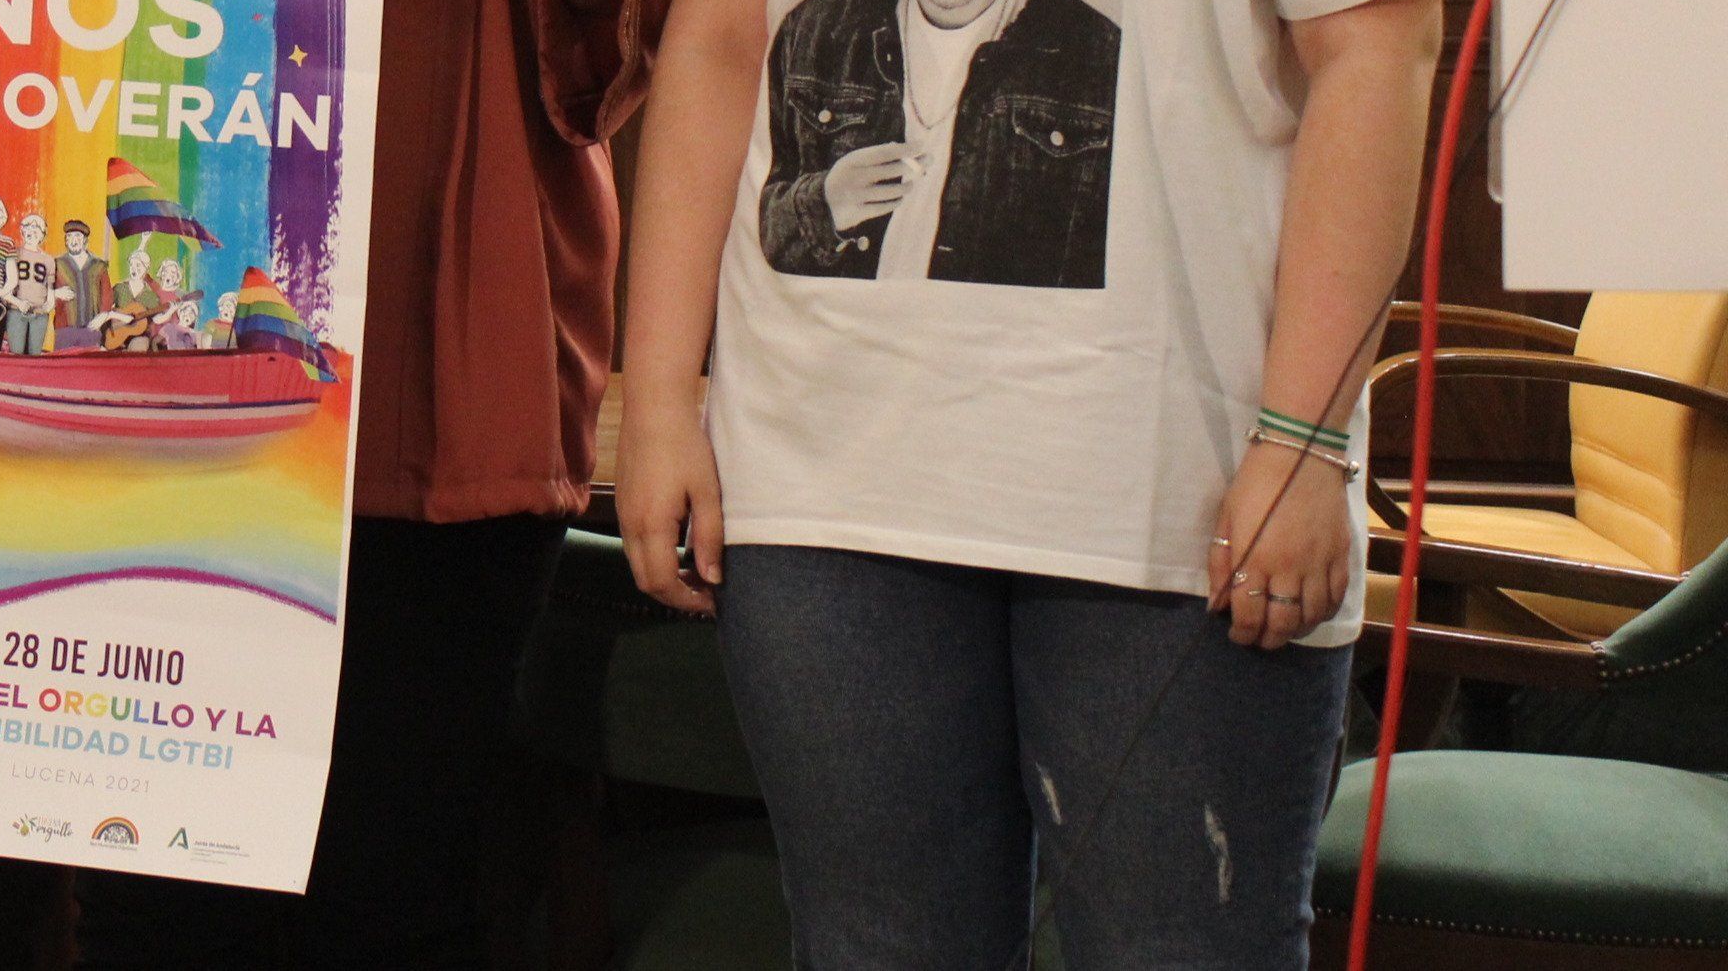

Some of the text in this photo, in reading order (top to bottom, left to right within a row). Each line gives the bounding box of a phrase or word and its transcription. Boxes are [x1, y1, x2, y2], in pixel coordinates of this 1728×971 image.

[3, 631, 185, 686] 28 DE JUNIO
[38, 688, 195, 729] ORGULLO
[205, 707, 227, 732] Y
[234, 712, 278, 739] LA
[138, 736, 234, 770] LGTBI
[11, 763, 151, 794] LUCENA 2021
